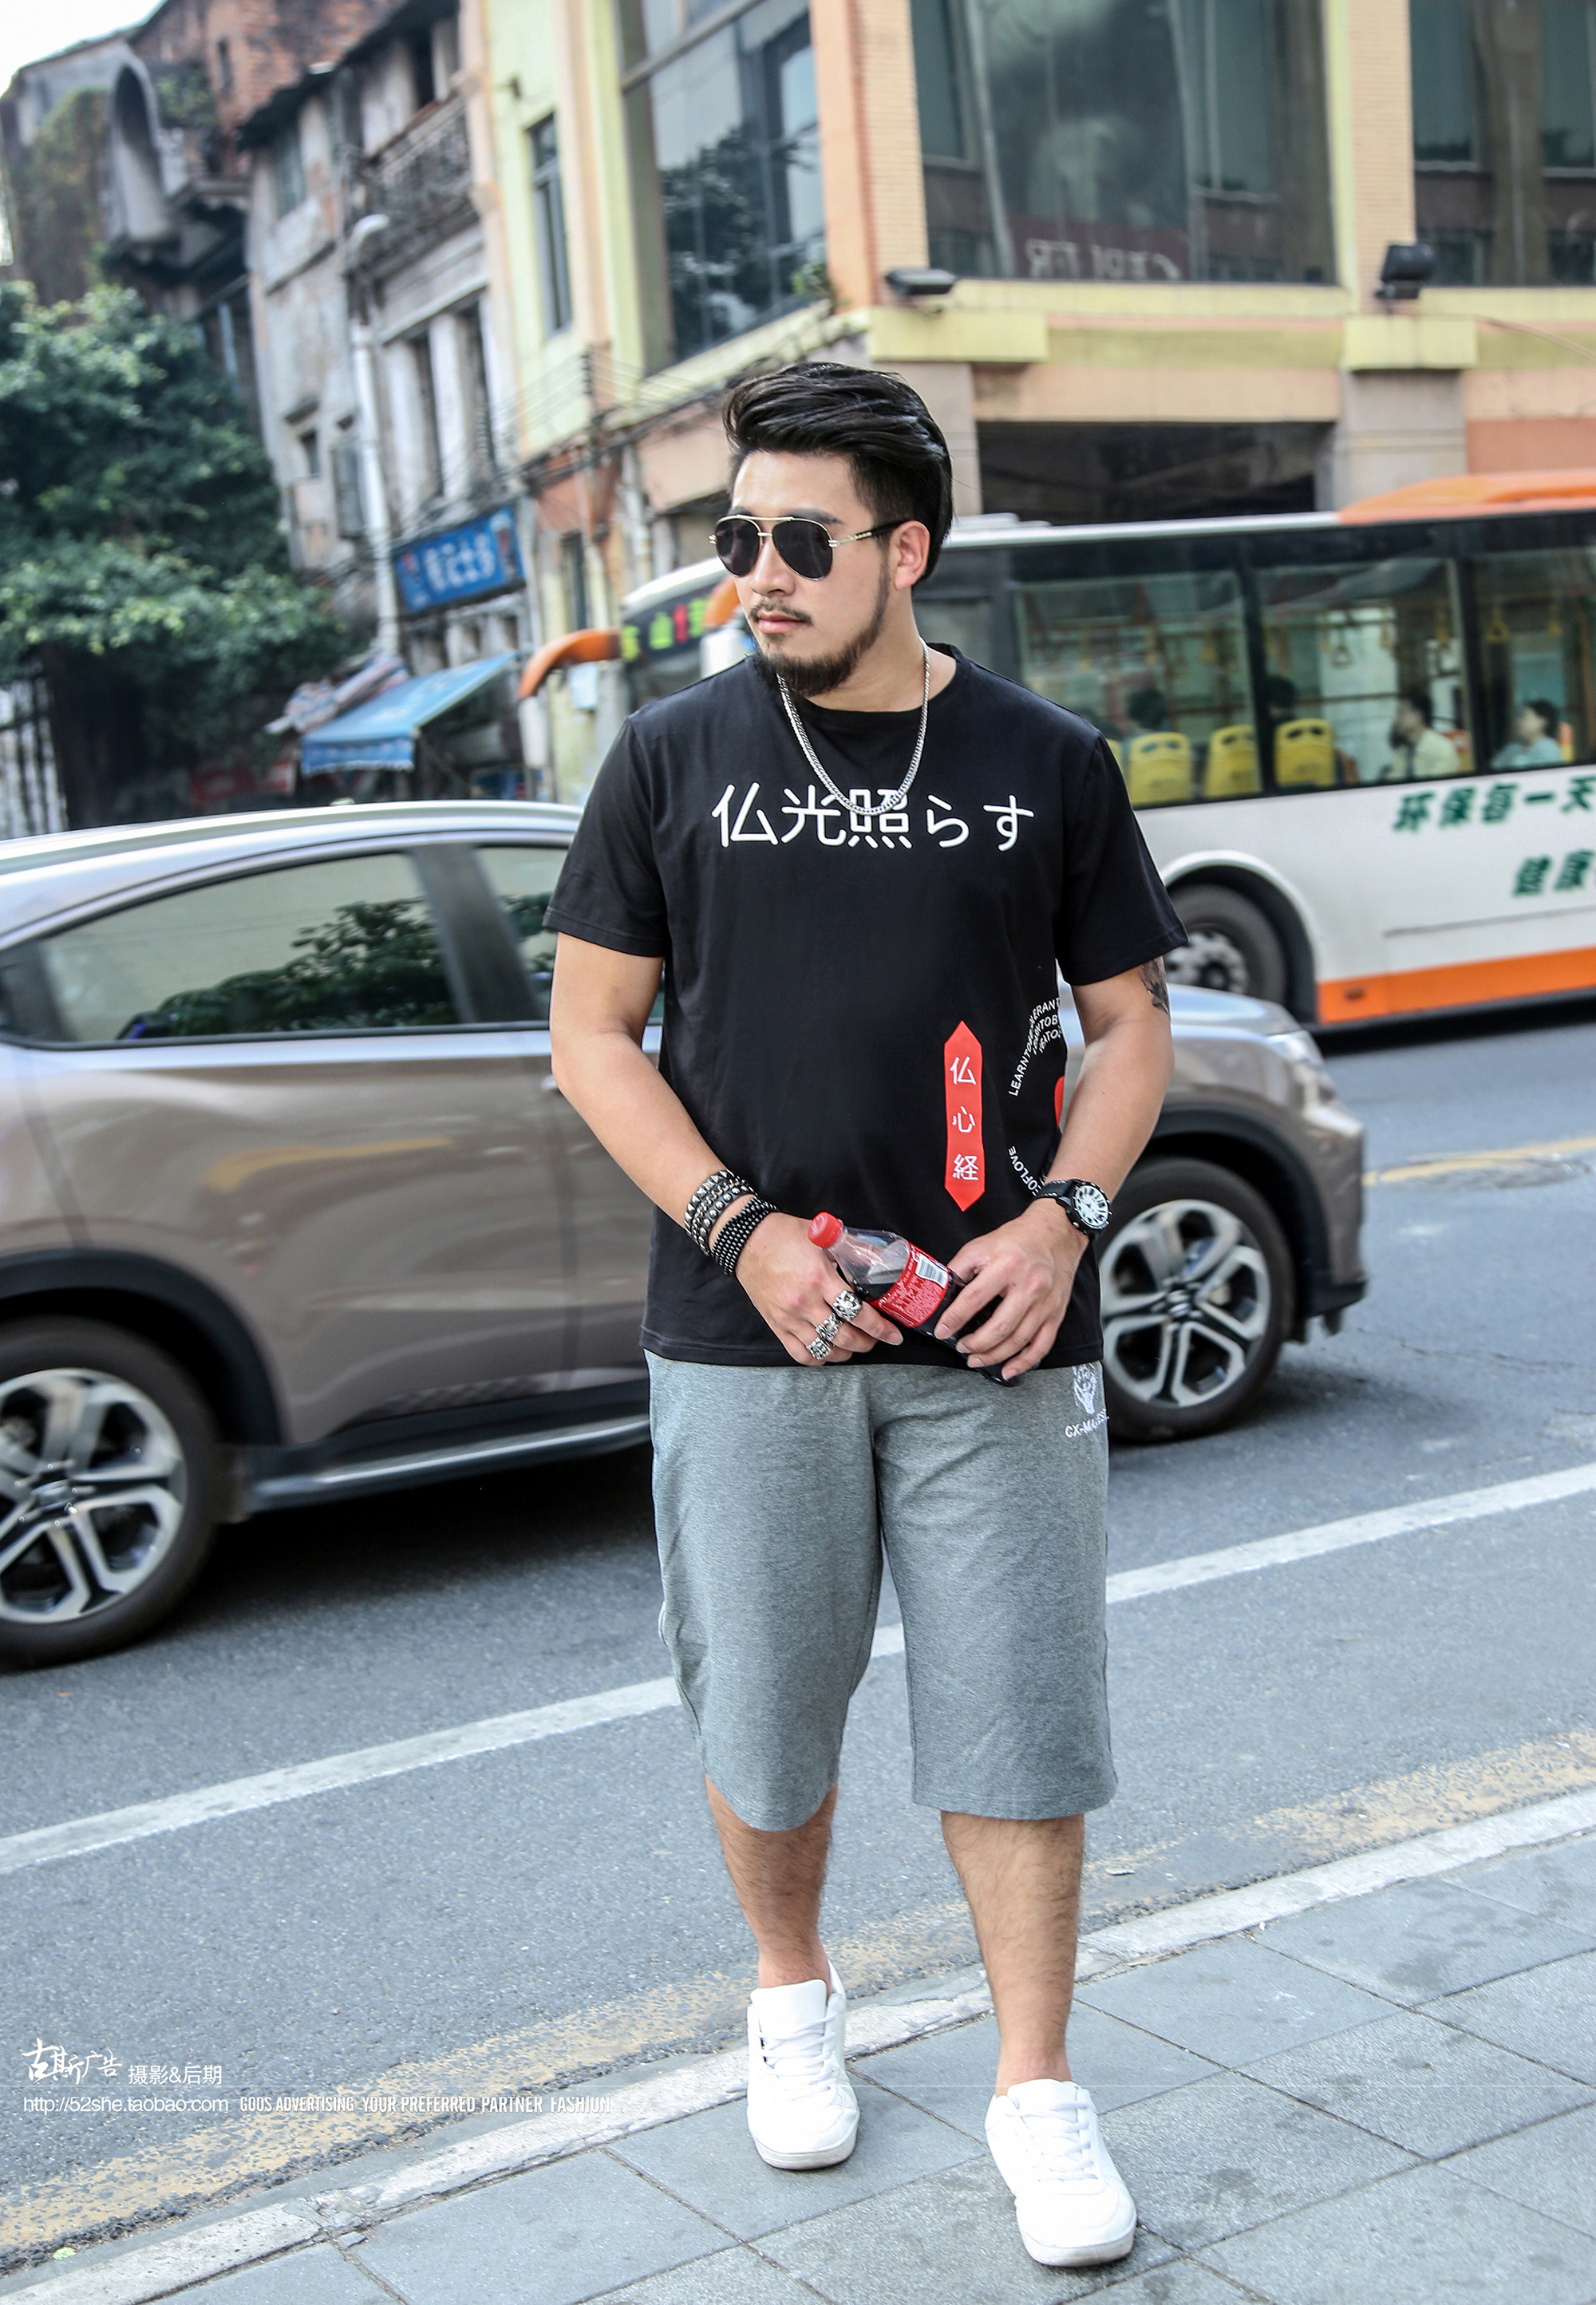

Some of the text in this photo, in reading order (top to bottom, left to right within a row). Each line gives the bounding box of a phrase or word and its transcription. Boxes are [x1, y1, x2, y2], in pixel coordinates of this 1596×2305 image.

[711, 781, 1035, 852] 仏光照らす
[1513, 850, 1596, 896] 健康
[950, 1056, 979, 1181] 仏心経
